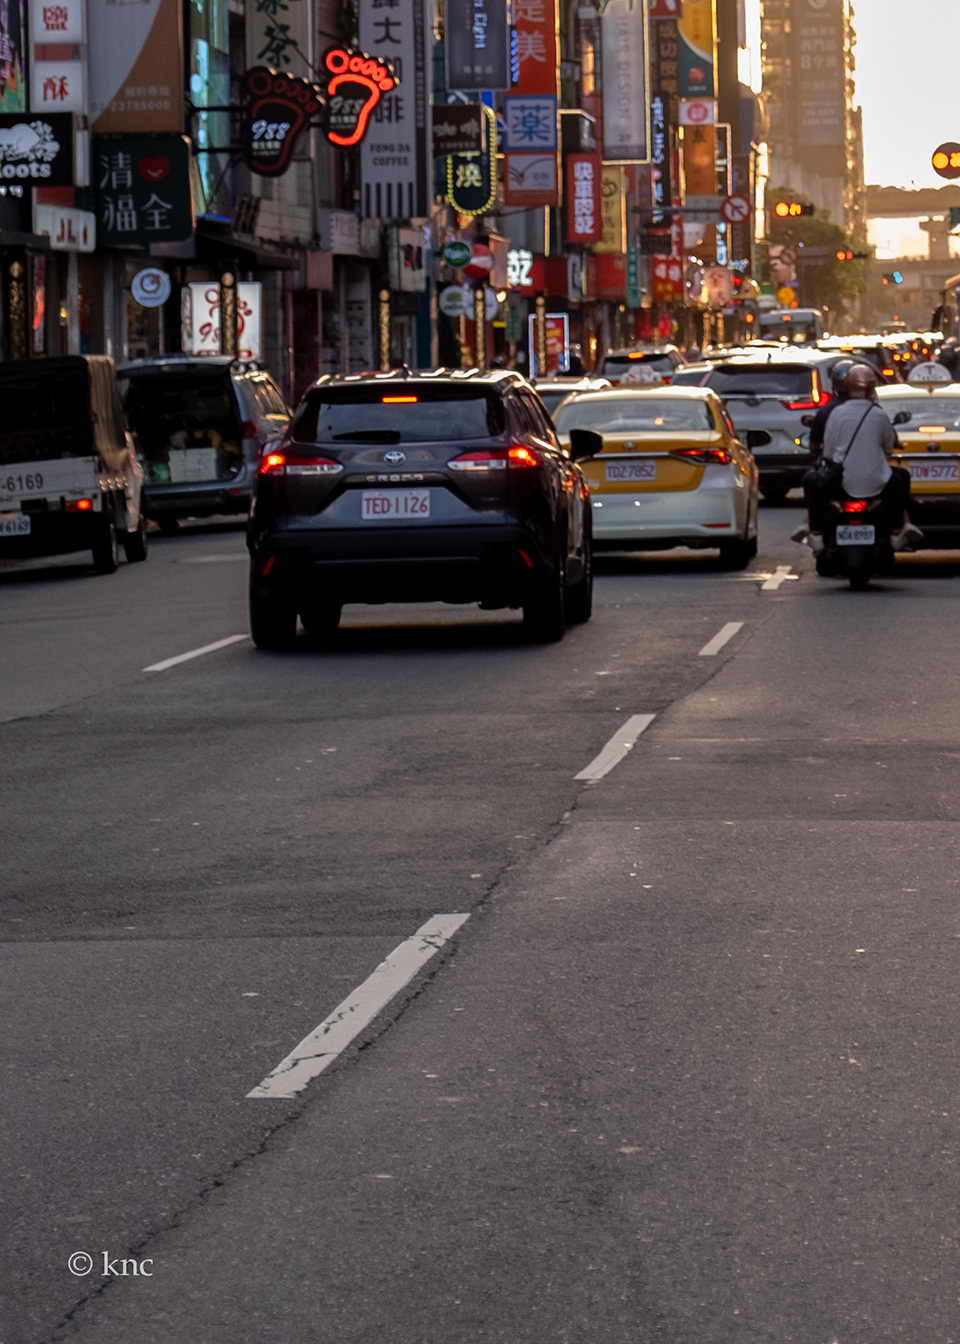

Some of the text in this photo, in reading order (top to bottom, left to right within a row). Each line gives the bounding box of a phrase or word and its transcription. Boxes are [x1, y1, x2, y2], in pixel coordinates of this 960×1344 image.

[251, 119, 291, 140] 988
[0, 161, 51, 178] oots
[102, 152, 133, 190] 清
[364, 496, 428, 515] TED-1126
